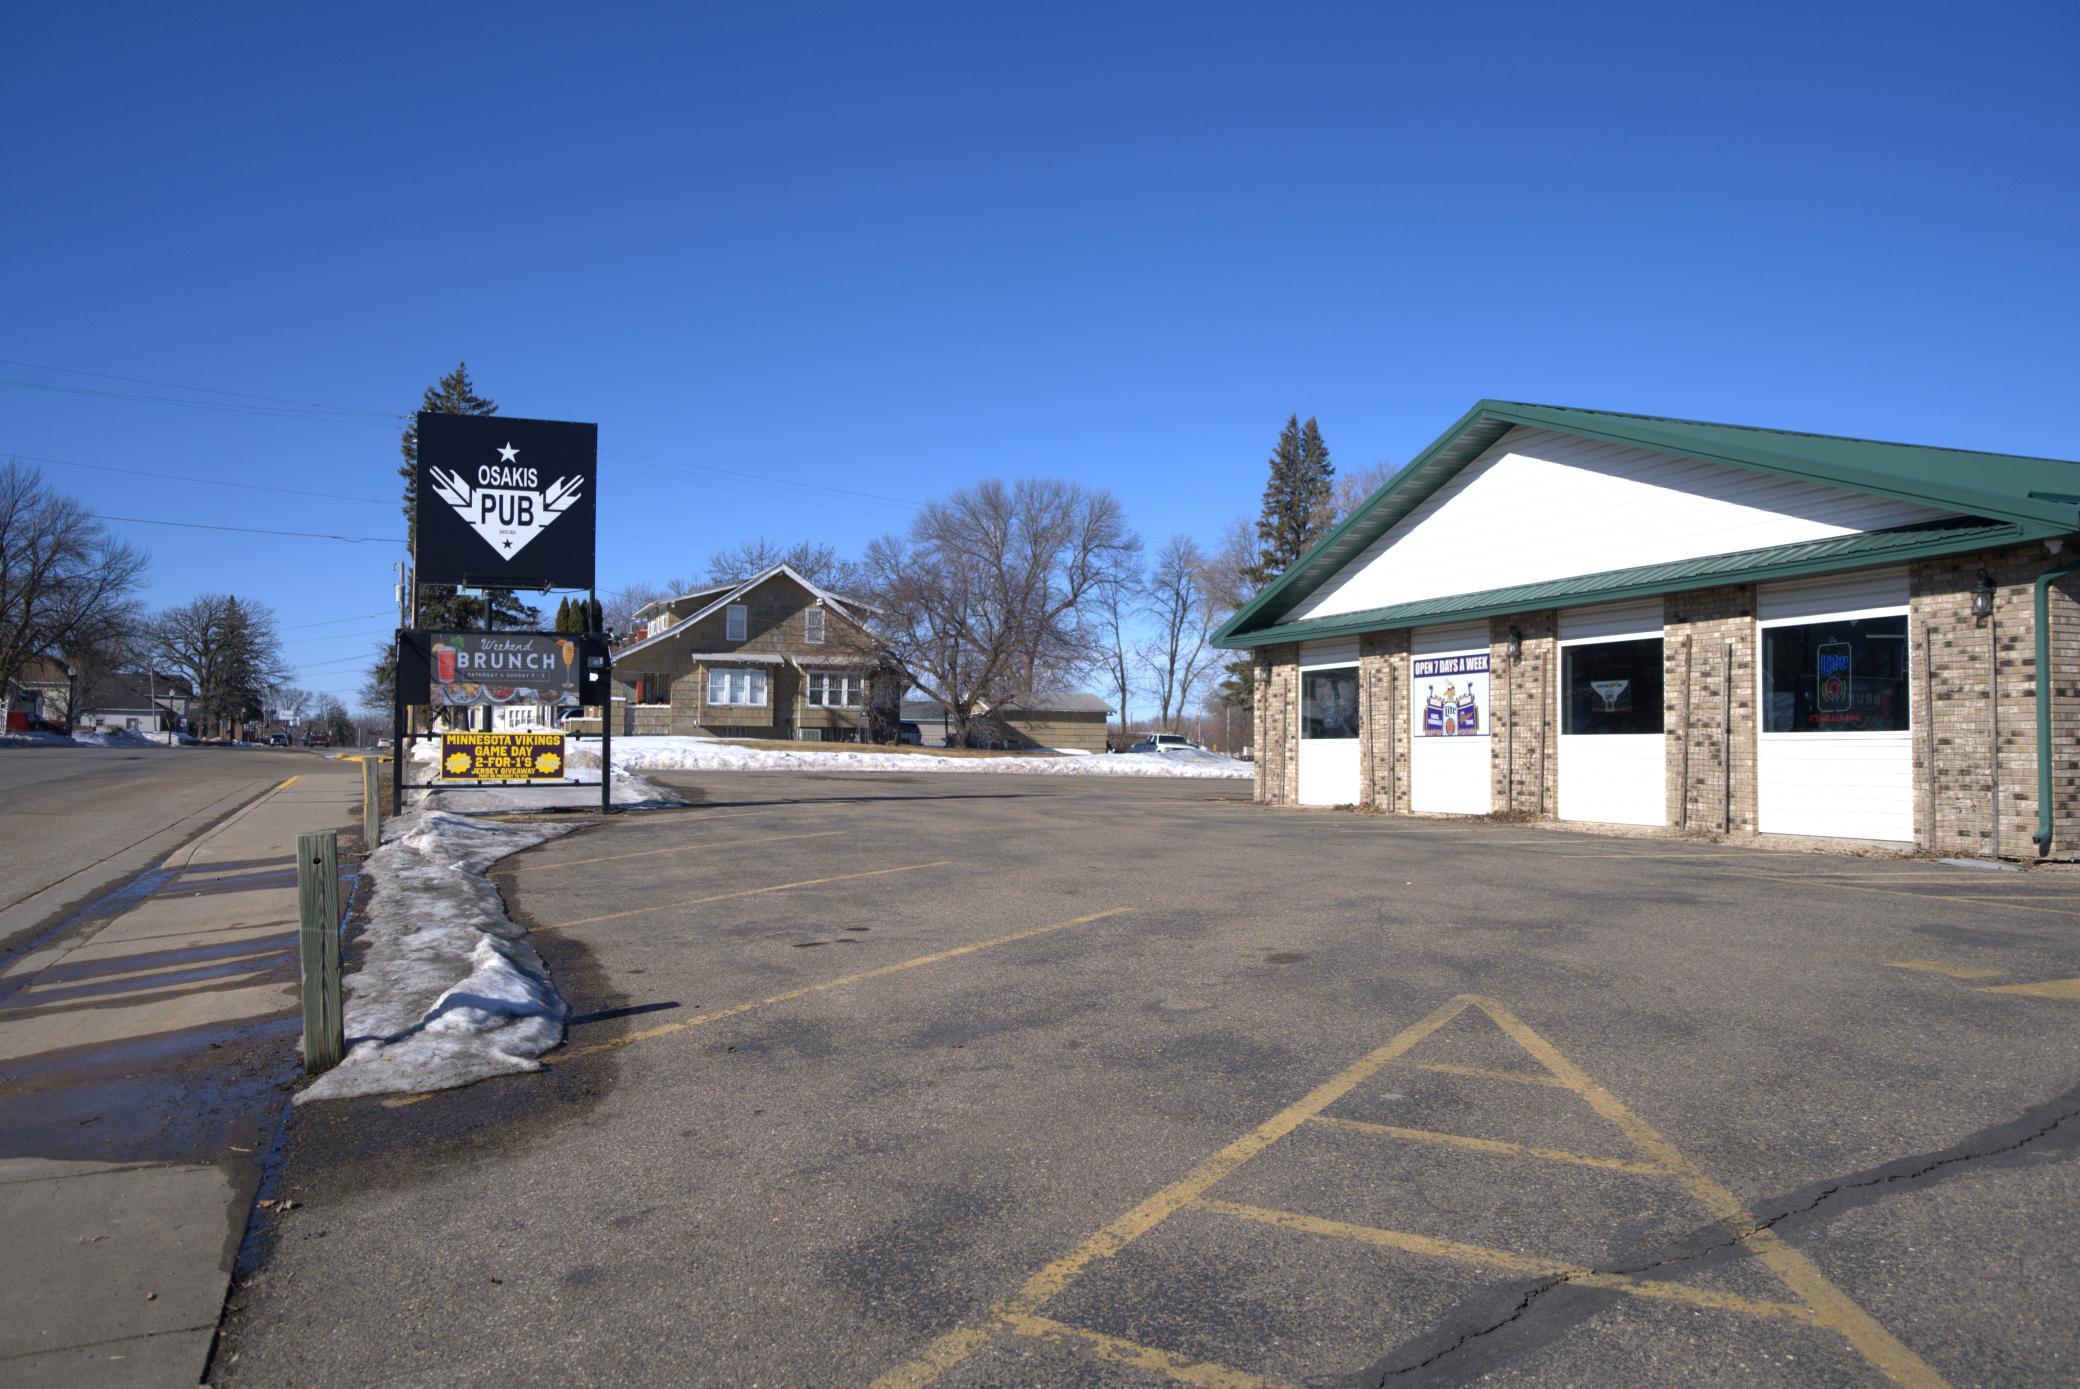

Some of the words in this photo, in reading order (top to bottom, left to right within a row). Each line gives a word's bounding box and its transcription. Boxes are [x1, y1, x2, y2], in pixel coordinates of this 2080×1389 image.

[478, 465, 538, 488] OSAKIS
[481, 493, 534, 527] PUB
[481, 638, 534, 651] Weekend
[457, 652, 555, 669] BRUNCH
[1415, 661, 1433, 676] OPEN
[1433, 660, 1438, 674] 7
[1440, 658, 1458, 673] DAYS
[1460, 657, 1465, 672] A
[1465, 656, 1488, 671] WEEK
[1445, 705, 1456, 717] Lite
[447, 734, 511, 745] MINNESOTA
[515, 735, 561, 746] VIKINGS
[475, 745, 507, 756] GAME
[511, 745, 533, 757] DAY
[475, 756, 532, 767] 2-FOR-1'S
